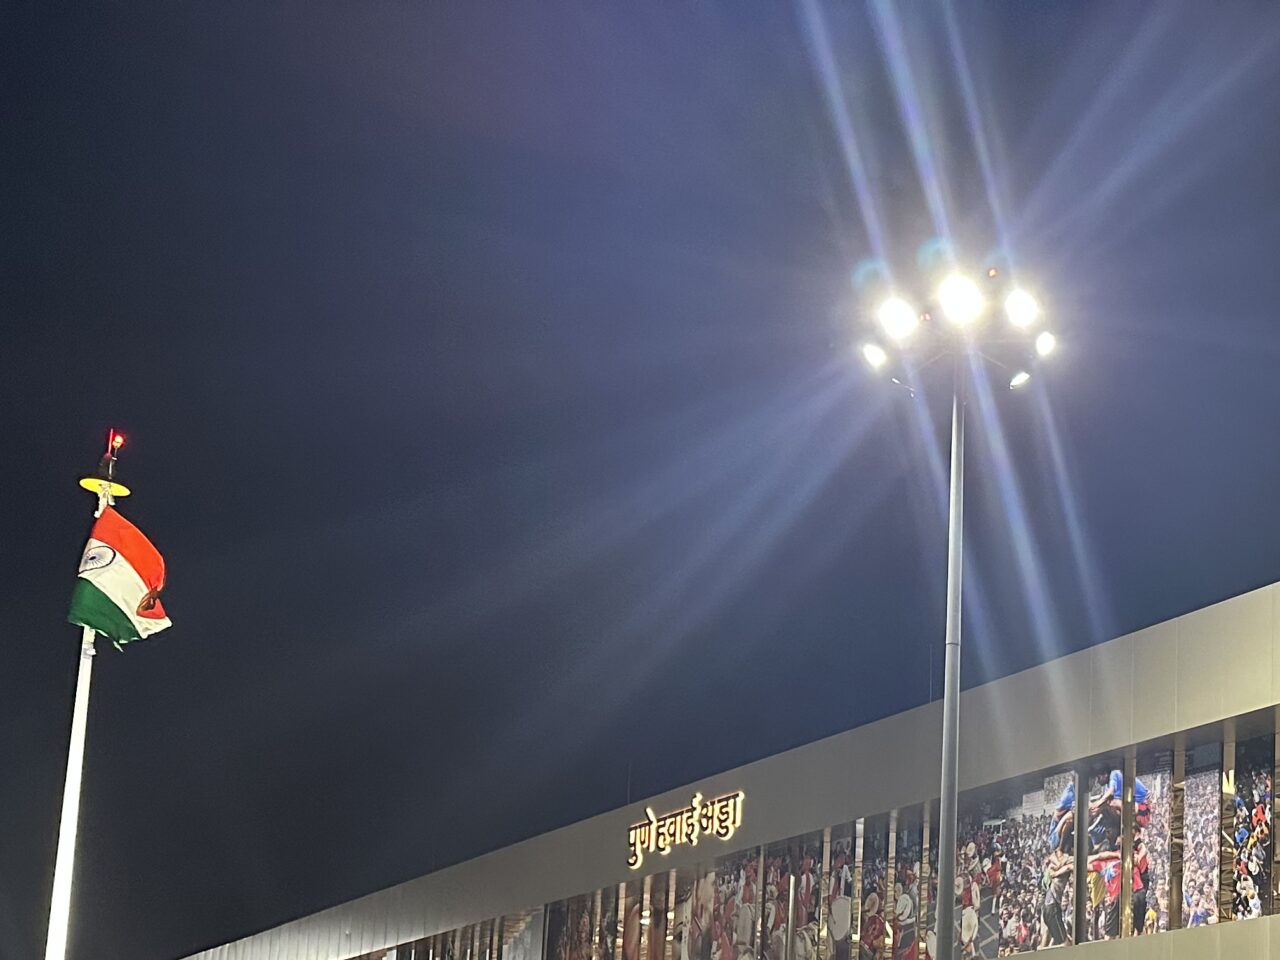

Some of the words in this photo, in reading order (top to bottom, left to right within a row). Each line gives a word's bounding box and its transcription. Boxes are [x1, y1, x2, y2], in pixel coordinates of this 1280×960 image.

[627, 807, 657, 870] पुणे
[656, 792, 703, 855] हवाई
[700, 790, 746, 841] अड्डा
